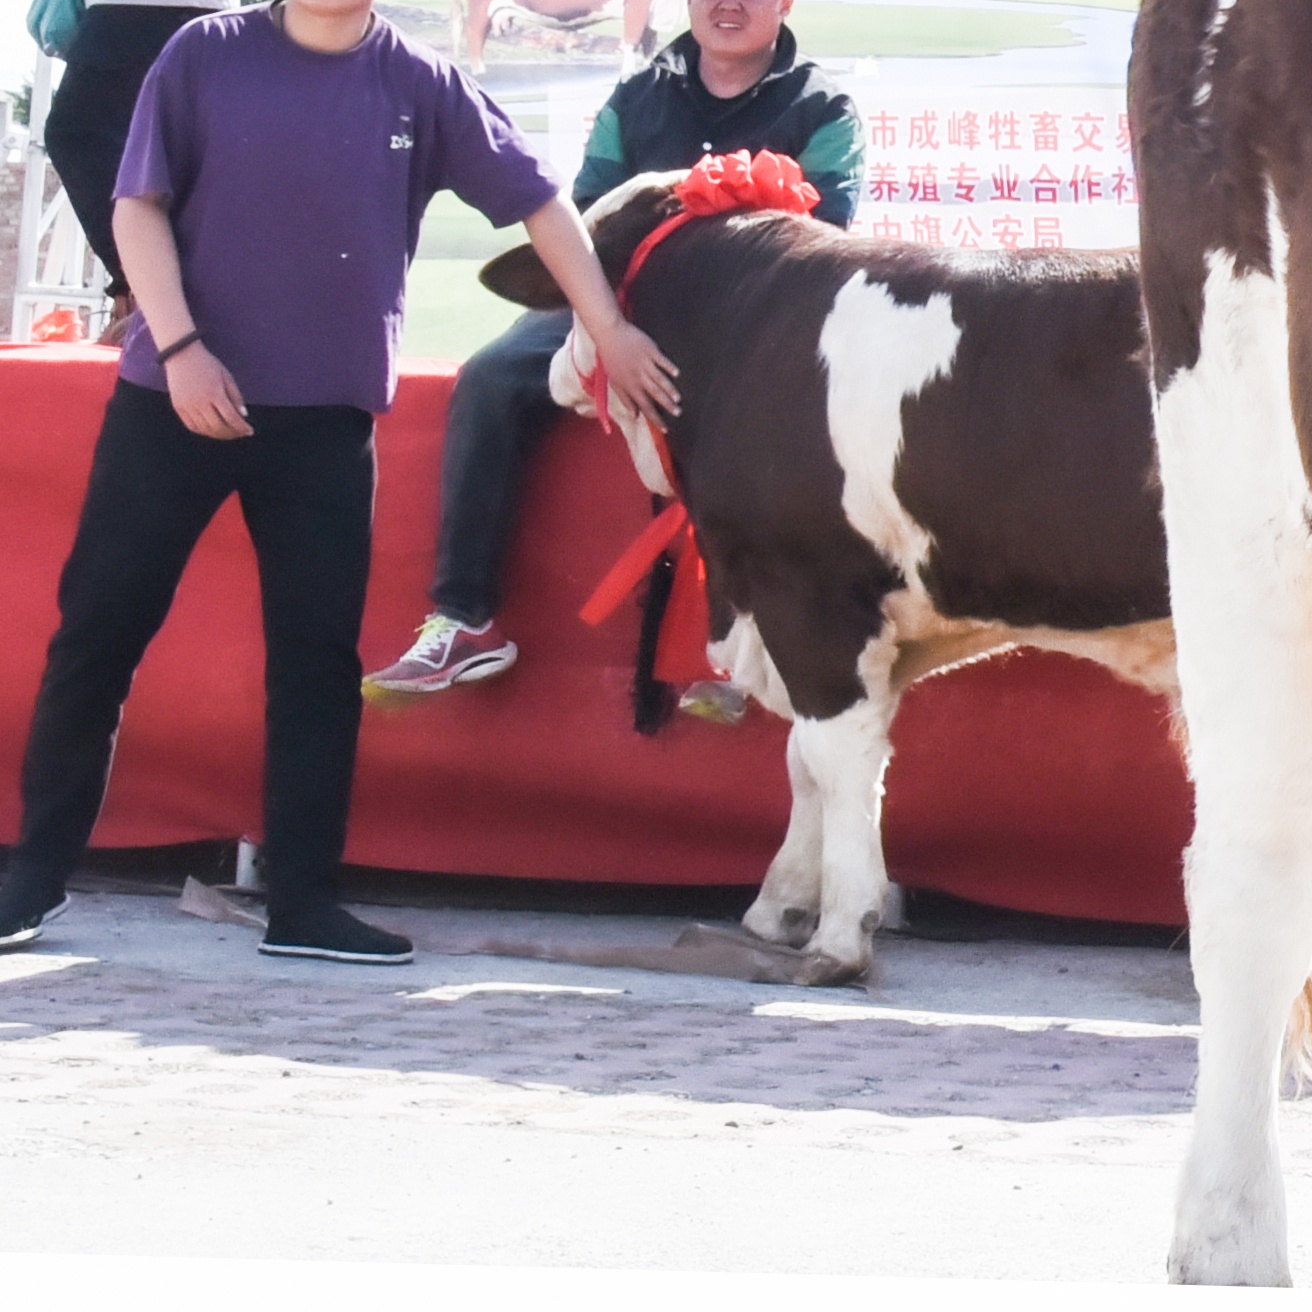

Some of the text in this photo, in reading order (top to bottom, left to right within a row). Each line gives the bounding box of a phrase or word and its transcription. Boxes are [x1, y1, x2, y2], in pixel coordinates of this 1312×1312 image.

[869, 162, 1140, 205] 养殖专业合作社
[851, 214, 1063, 249] 中旗公安局
